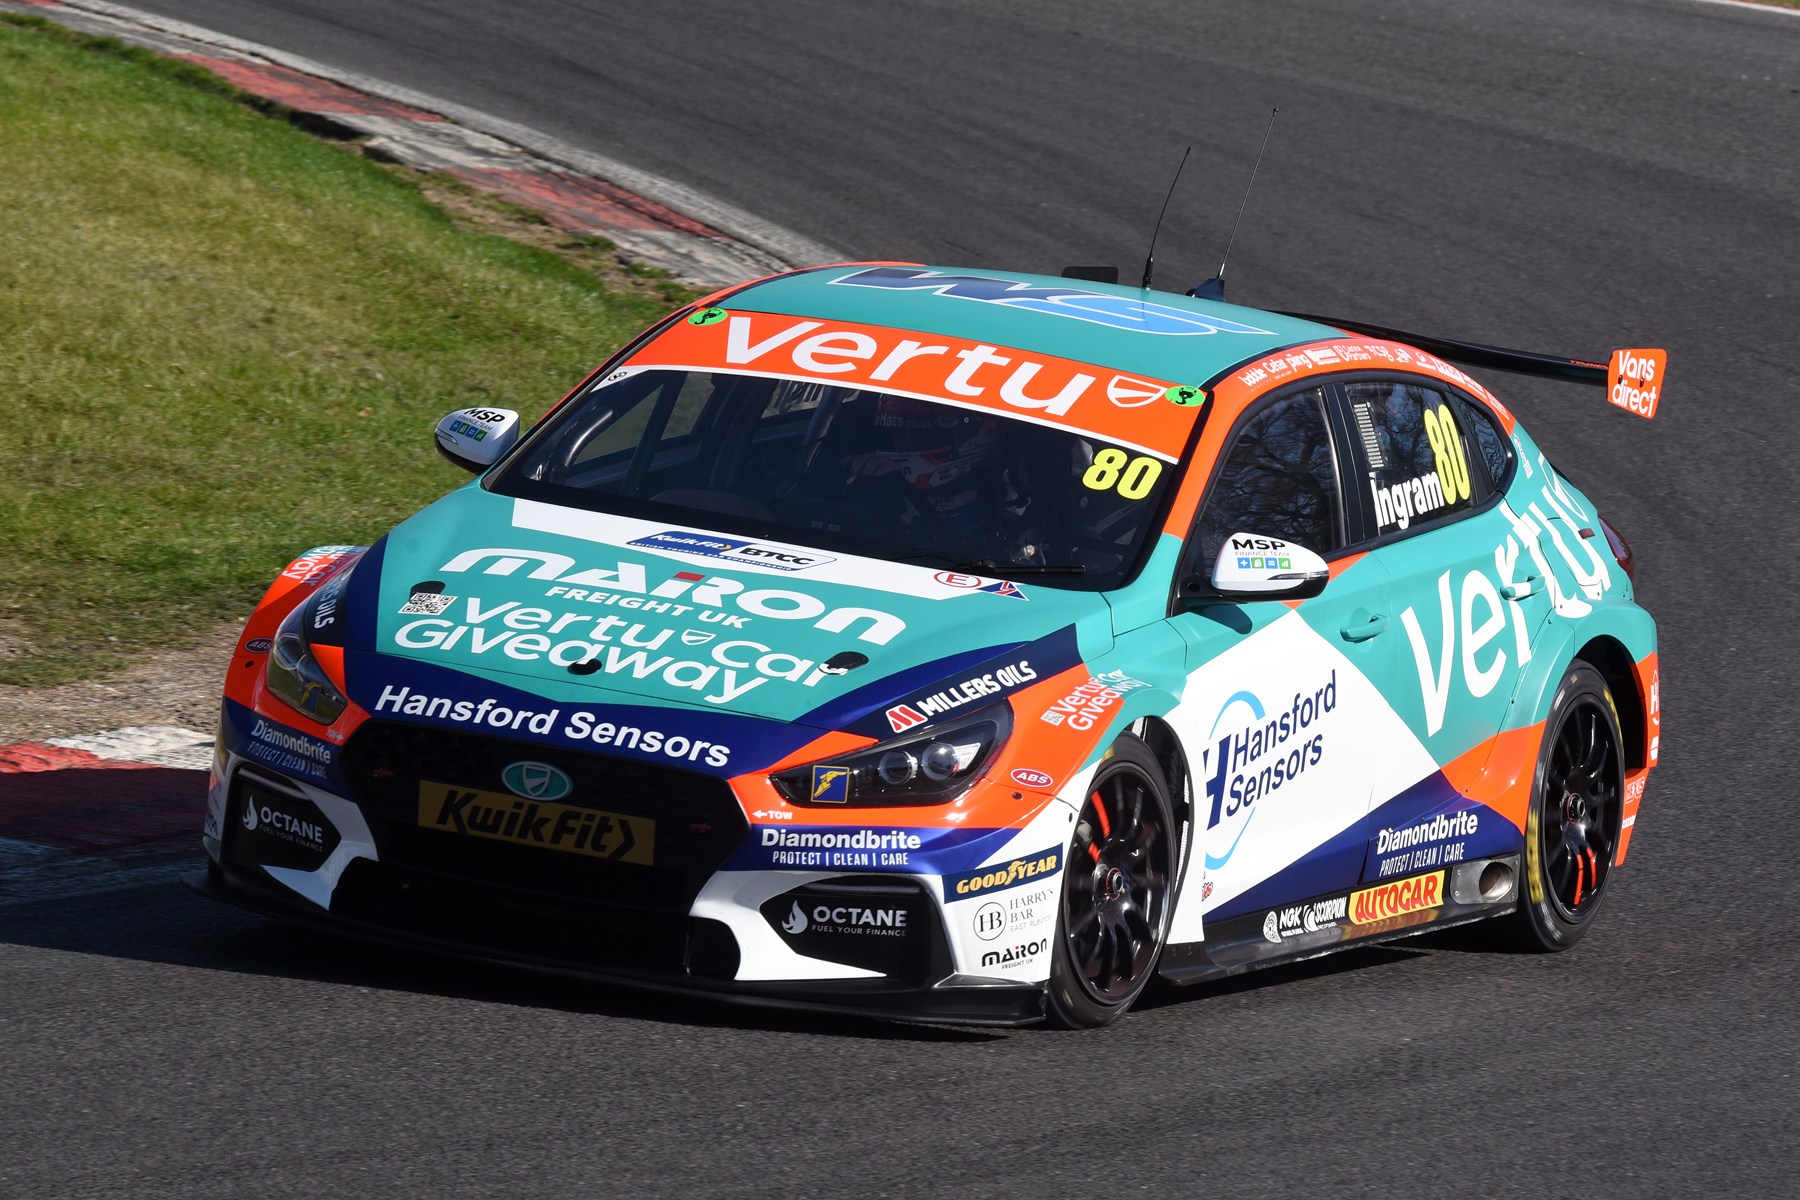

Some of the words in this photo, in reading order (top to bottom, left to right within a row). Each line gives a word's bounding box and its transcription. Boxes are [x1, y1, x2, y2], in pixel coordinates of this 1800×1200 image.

[1618, 350, 1655, 381] Vans
[1612, 380, 1656, 417] direct
[463, 408, 506, 423] MSP
[1423, 404, 1471, 505] 80
[1082, 447, 1163, 500] 80
[738, 547, 816, 565] BTCC
[1231, 538, 1286, 550] MSP
[314, 599, 337, 629] OILS
[544, 586, 694, 616] FREIGHT
[698, 610, 753, 628] UK
[711, 640, 849, 687] Car
[916, 674, 1002, 717] MILLERS
[996, 660, 1037, 688] OILS
[374, 685, 560, 735] Hansford
[564, 711, 732, 768] Sensors
[1231, 668, 1337, 774] Hansford
[248, 741, 281, 762] PROTECT
[282, 754, 305, 773] CLEAN
[251, 719, 332, 765] Diamondbrite
[1016, 772, 1048, 784] ABS
[1226, 733, 1323, 818] Sensors
[260, 806, 323, 843] OCTANE
[767, 811, 793, 820] TOW
[259, 824, 274, 835] FUEL
[276, 830, 293, 842] YOUR
[295, 838, 323, 853] FINANCE
[761, 828, 921, 850] Diamondbrite
[1376, 811, 1479, 855] Diamondbrite
[772, 851, 821, 865] PROTECT
[833, 852, 869, 866] CLEAN
[881, 852, 909, 866] CARE
[956, 855, 1058, 894] GOODYEAR
[1379, 852, 1410, 877] PROTECT
[1414, 847, 1438, 869] CLEAN
[1444, 842, 1465, 863] CARE
[813, 906, 908, 927] OCTANE
[1010, 908, 1034, 924] BAR
[1279, 906, 1302, 930] NGK
[1315, 896, 1348, 924] SCORPION
[1355, 874, 1438, 923] AUTOCAR
[811, 925, 834, 933] FUEL
[837, 926, 863, 935] YOUR
[866, 928, 906, 937] FINANCE
[1002, 960, 1025, 970] FREIGHT
